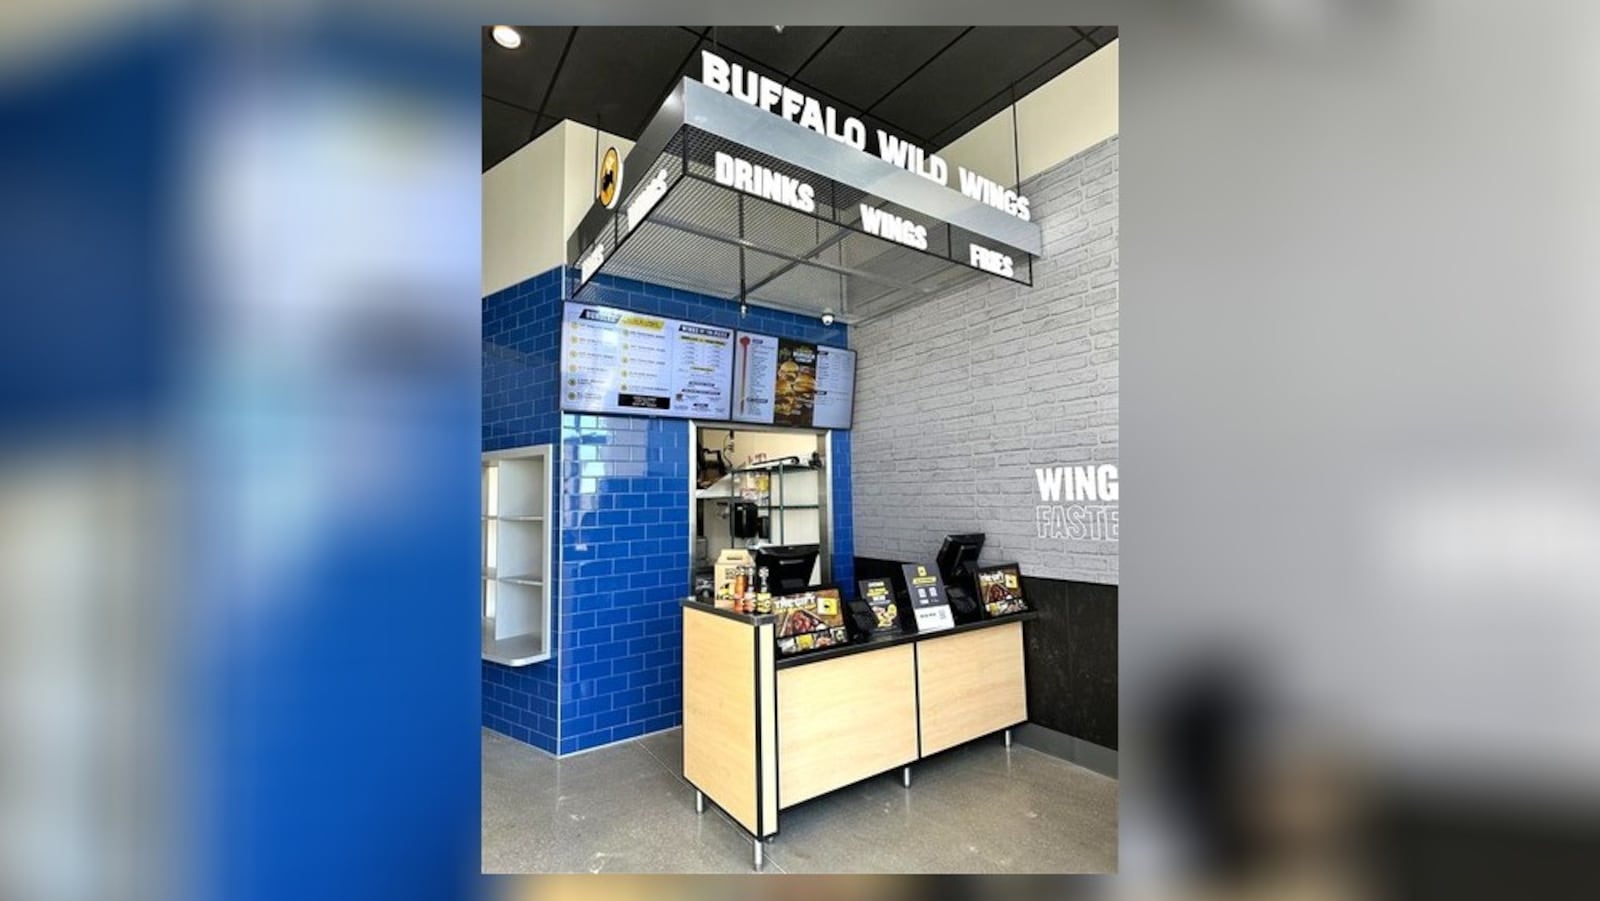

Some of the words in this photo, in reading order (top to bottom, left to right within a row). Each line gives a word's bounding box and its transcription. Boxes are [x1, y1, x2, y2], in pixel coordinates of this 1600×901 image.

[701, 50, 867, 152] BUFFALO
[876, 129, 948, 187] WILD
[958, 166, 1031, 222] WINGS
[715, 151, 815, 213] DRINKS
[860, 203, 928, 250] WINGS
[969, 243, 1014, 278] FRIES
[1035, 464, 1119, 502] WING
